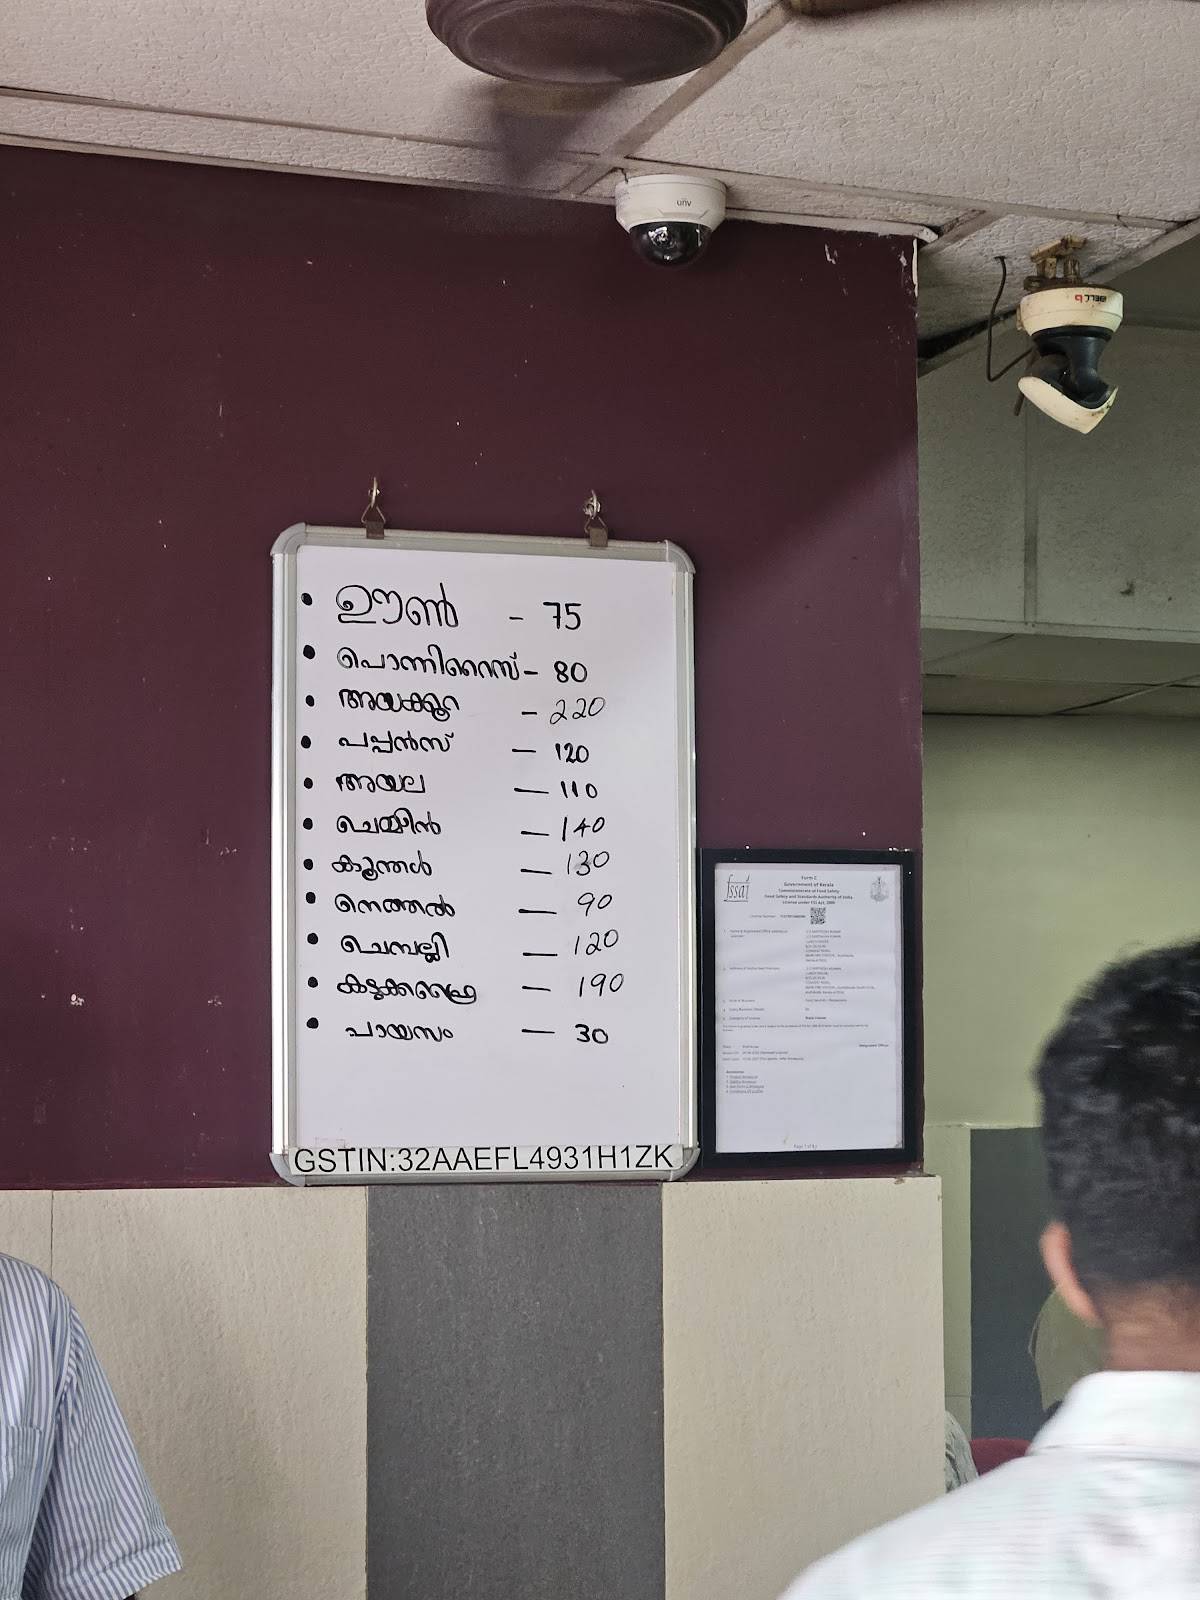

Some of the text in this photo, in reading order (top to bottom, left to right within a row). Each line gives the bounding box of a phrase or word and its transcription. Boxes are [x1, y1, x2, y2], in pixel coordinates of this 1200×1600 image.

[542, 602, 582, 631] 75
[554, 661, 588, 684] 80
[549, 697, 607, 726] 220
[554, 742, 590, 764] 120
[335, 772, 426, 794] അയല
[560, 780, 599, 799] 110
[561, 815, 606, 843] 140
[566, 850, 611, 877] 130
[577, 892, 614, 917] 90
[574, 928, 620, 956] 120
[579, 972, 625, 998] 190
[574, 1023, 609, 1045] 30
[293, 1144, 674, 1173] GSTIN:32AAEFL4931H1ZK
